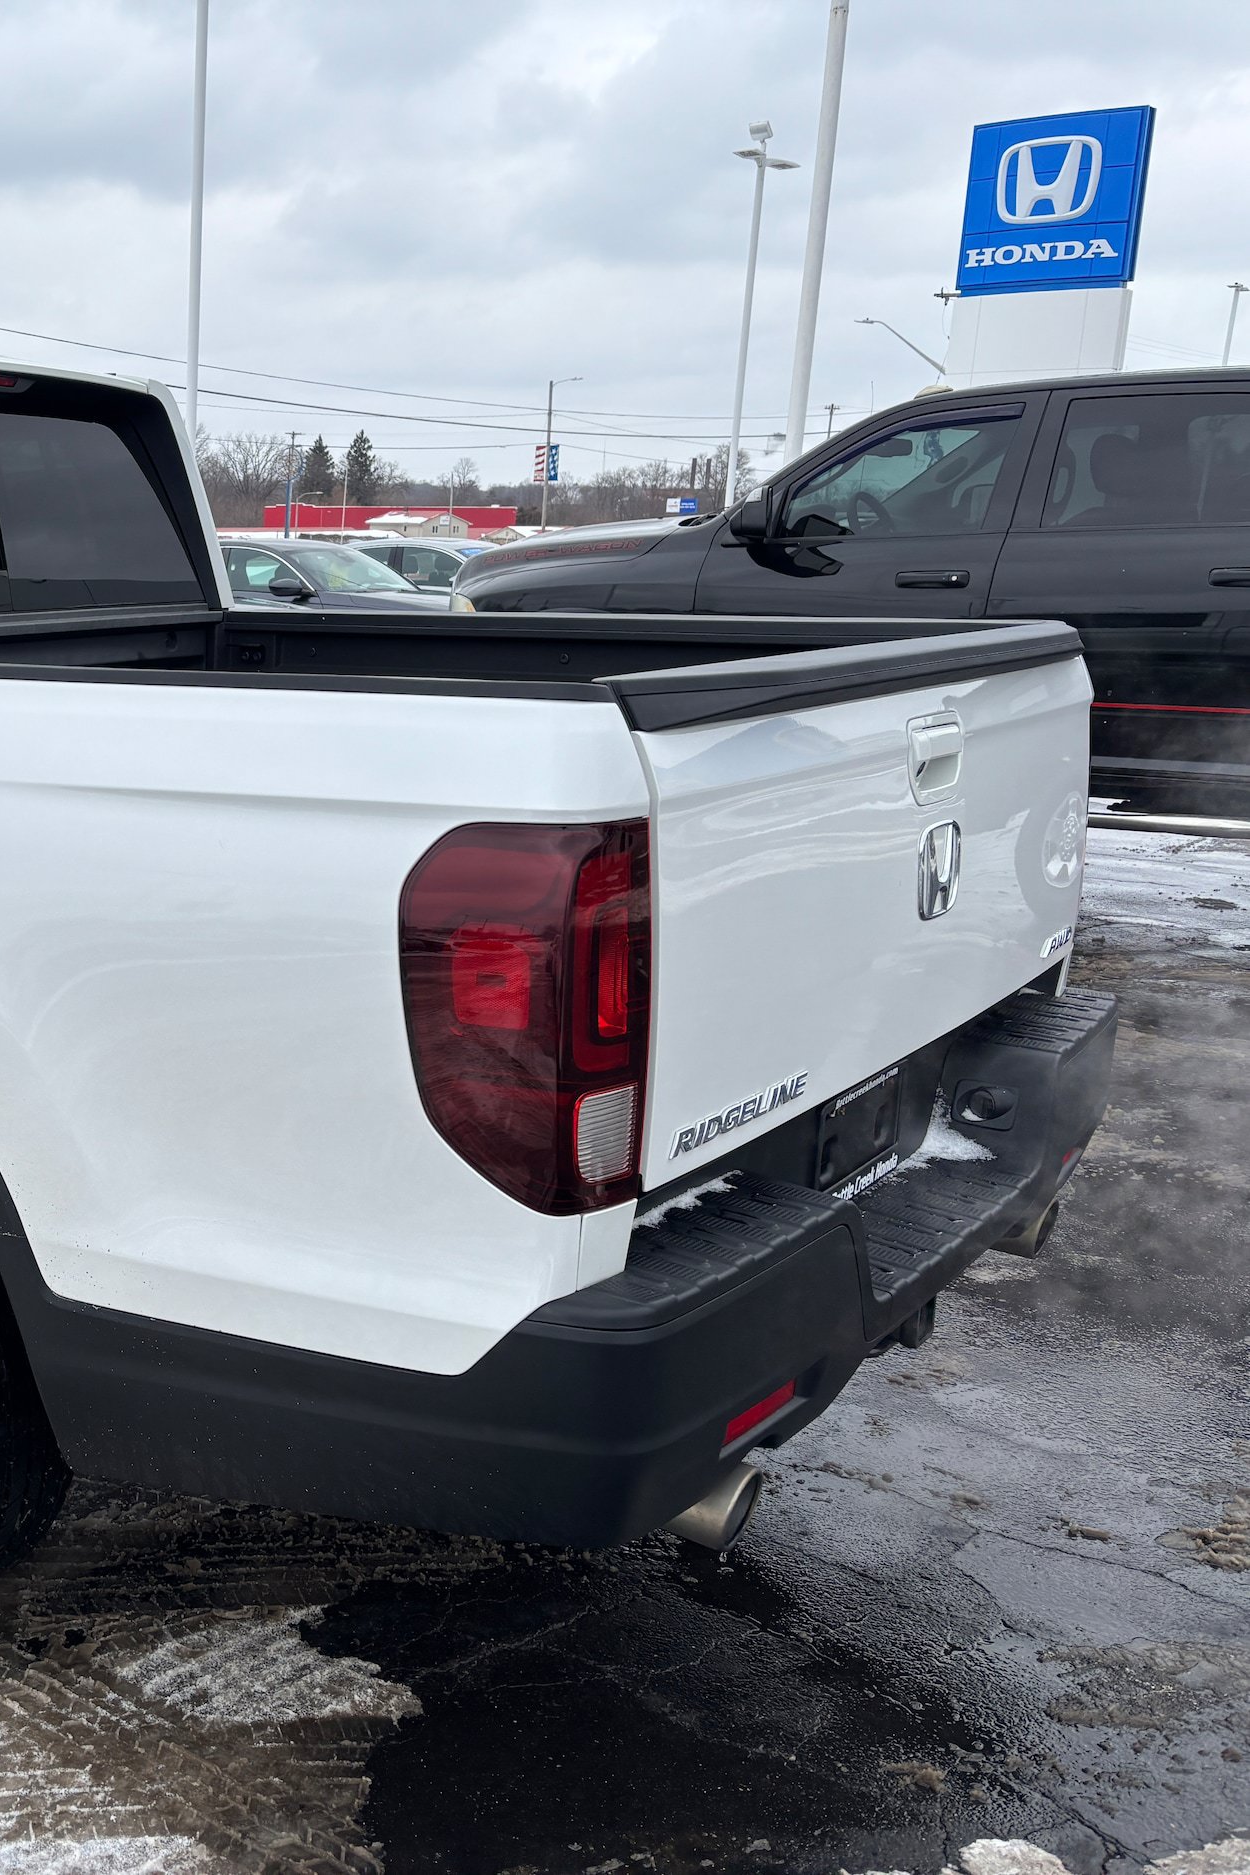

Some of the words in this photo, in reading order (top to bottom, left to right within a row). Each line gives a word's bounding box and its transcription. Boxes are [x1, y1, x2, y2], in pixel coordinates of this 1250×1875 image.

[965, 238, 1118, 268] HONDA
[668, 1070, 809, 1160] RIDGELINE
[854, 1166, 875, 1195] Creek
[874, 1152, 899, 1181] Honda
